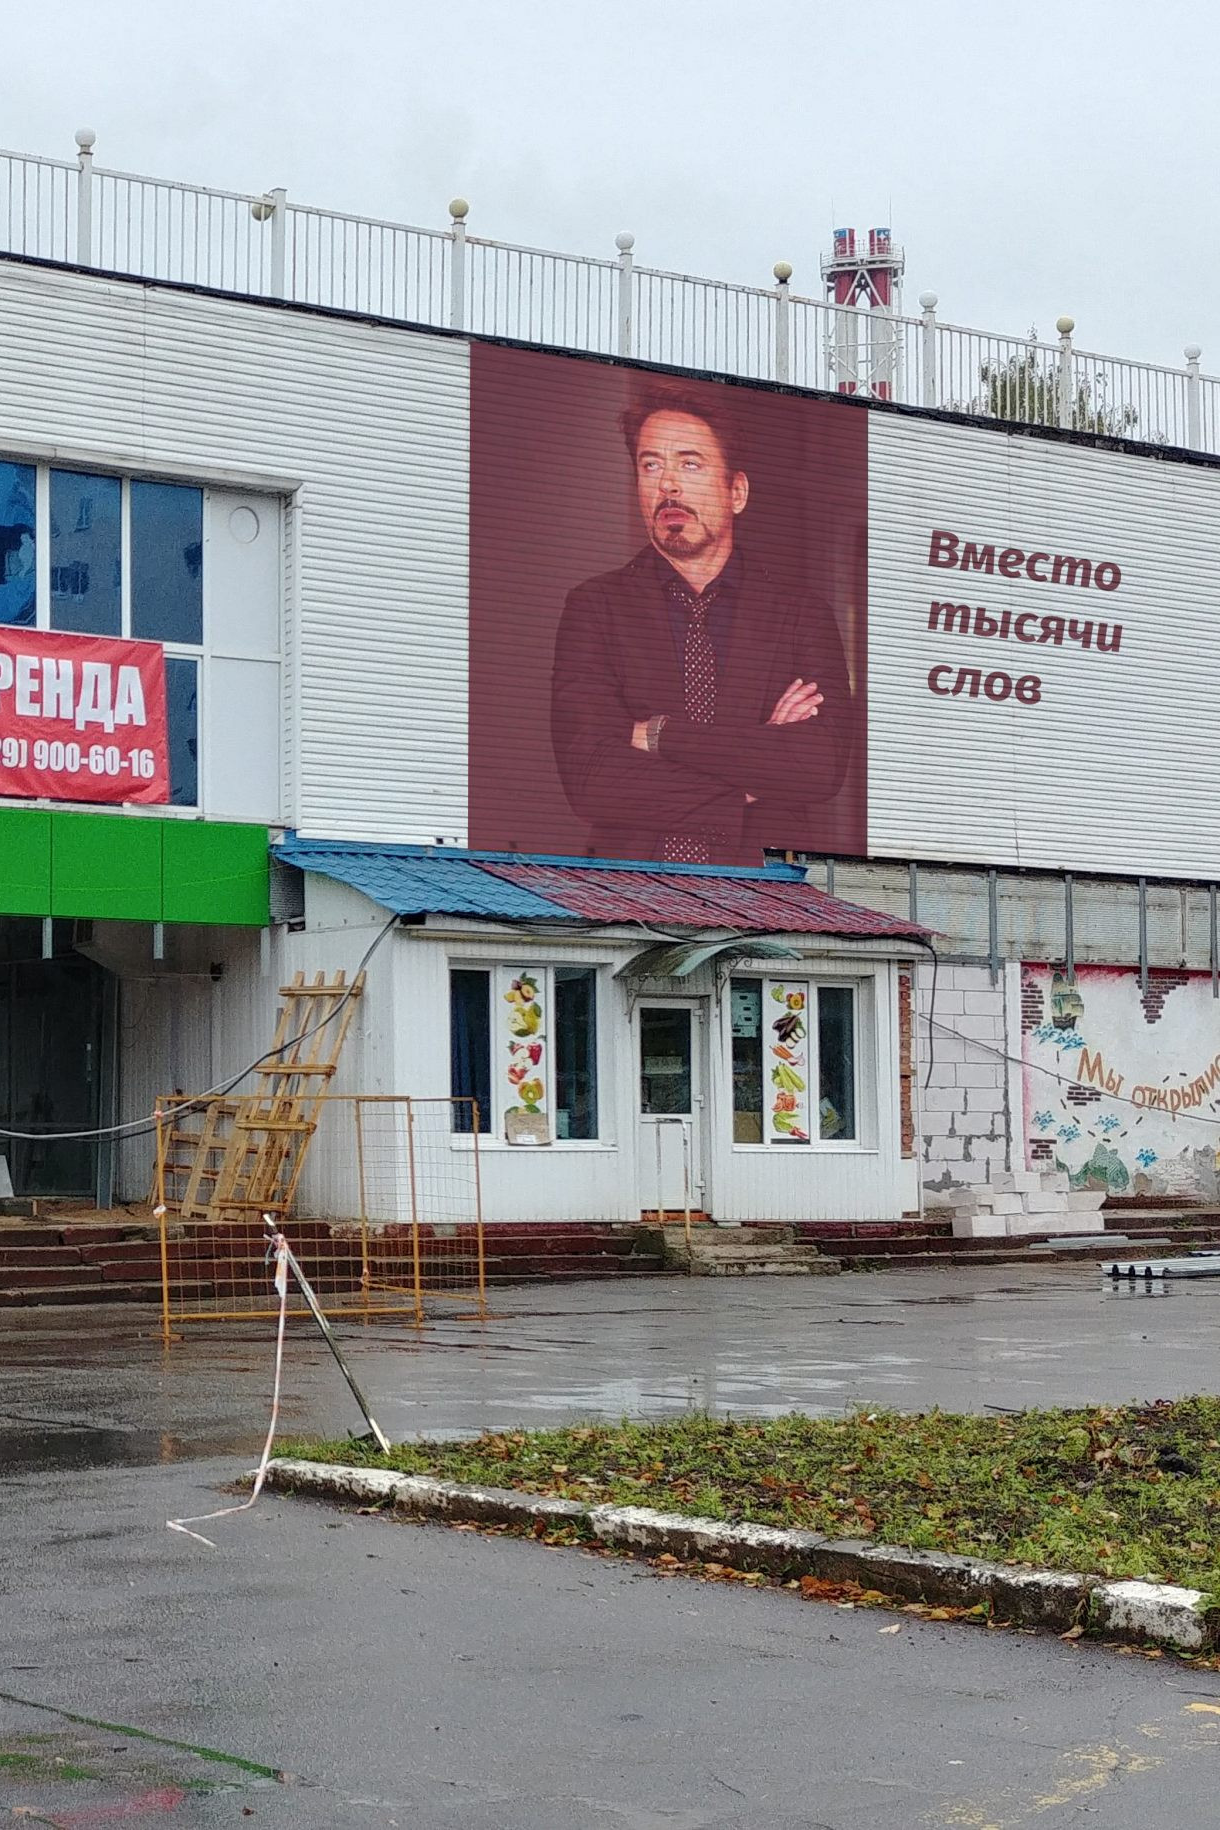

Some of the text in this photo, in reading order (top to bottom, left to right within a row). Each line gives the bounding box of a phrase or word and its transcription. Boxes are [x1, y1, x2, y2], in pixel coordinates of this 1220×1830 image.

[928, 529, 1122, 591] Вместо
[927, 601, 1123, 652] тысячи
[927, 665, 1042, 705] слов
[33, 740, 155, 778] 900-60-16
[1077, 1047, 1124, 1096] Мы
